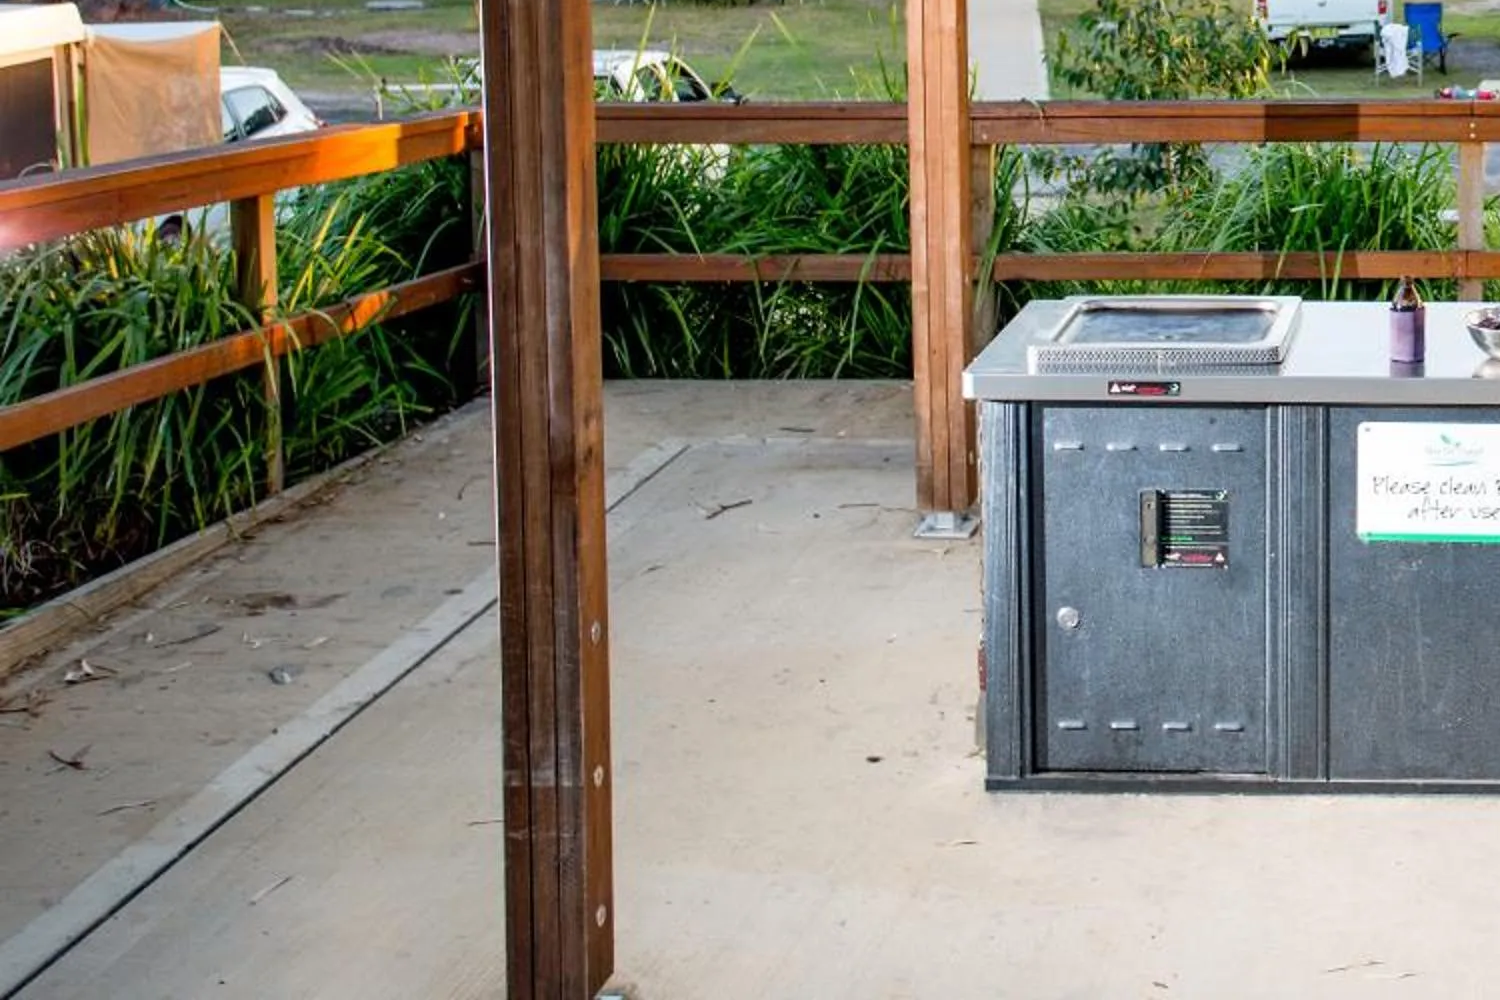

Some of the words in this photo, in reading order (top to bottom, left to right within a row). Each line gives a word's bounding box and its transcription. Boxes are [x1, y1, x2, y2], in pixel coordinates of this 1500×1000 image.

[1373, 476, 1431, 495] Please
[1439, 476, 1487, 495] clean
[1407, 496, 1464, 520] after
[1469, 507, 1500, 520] use
